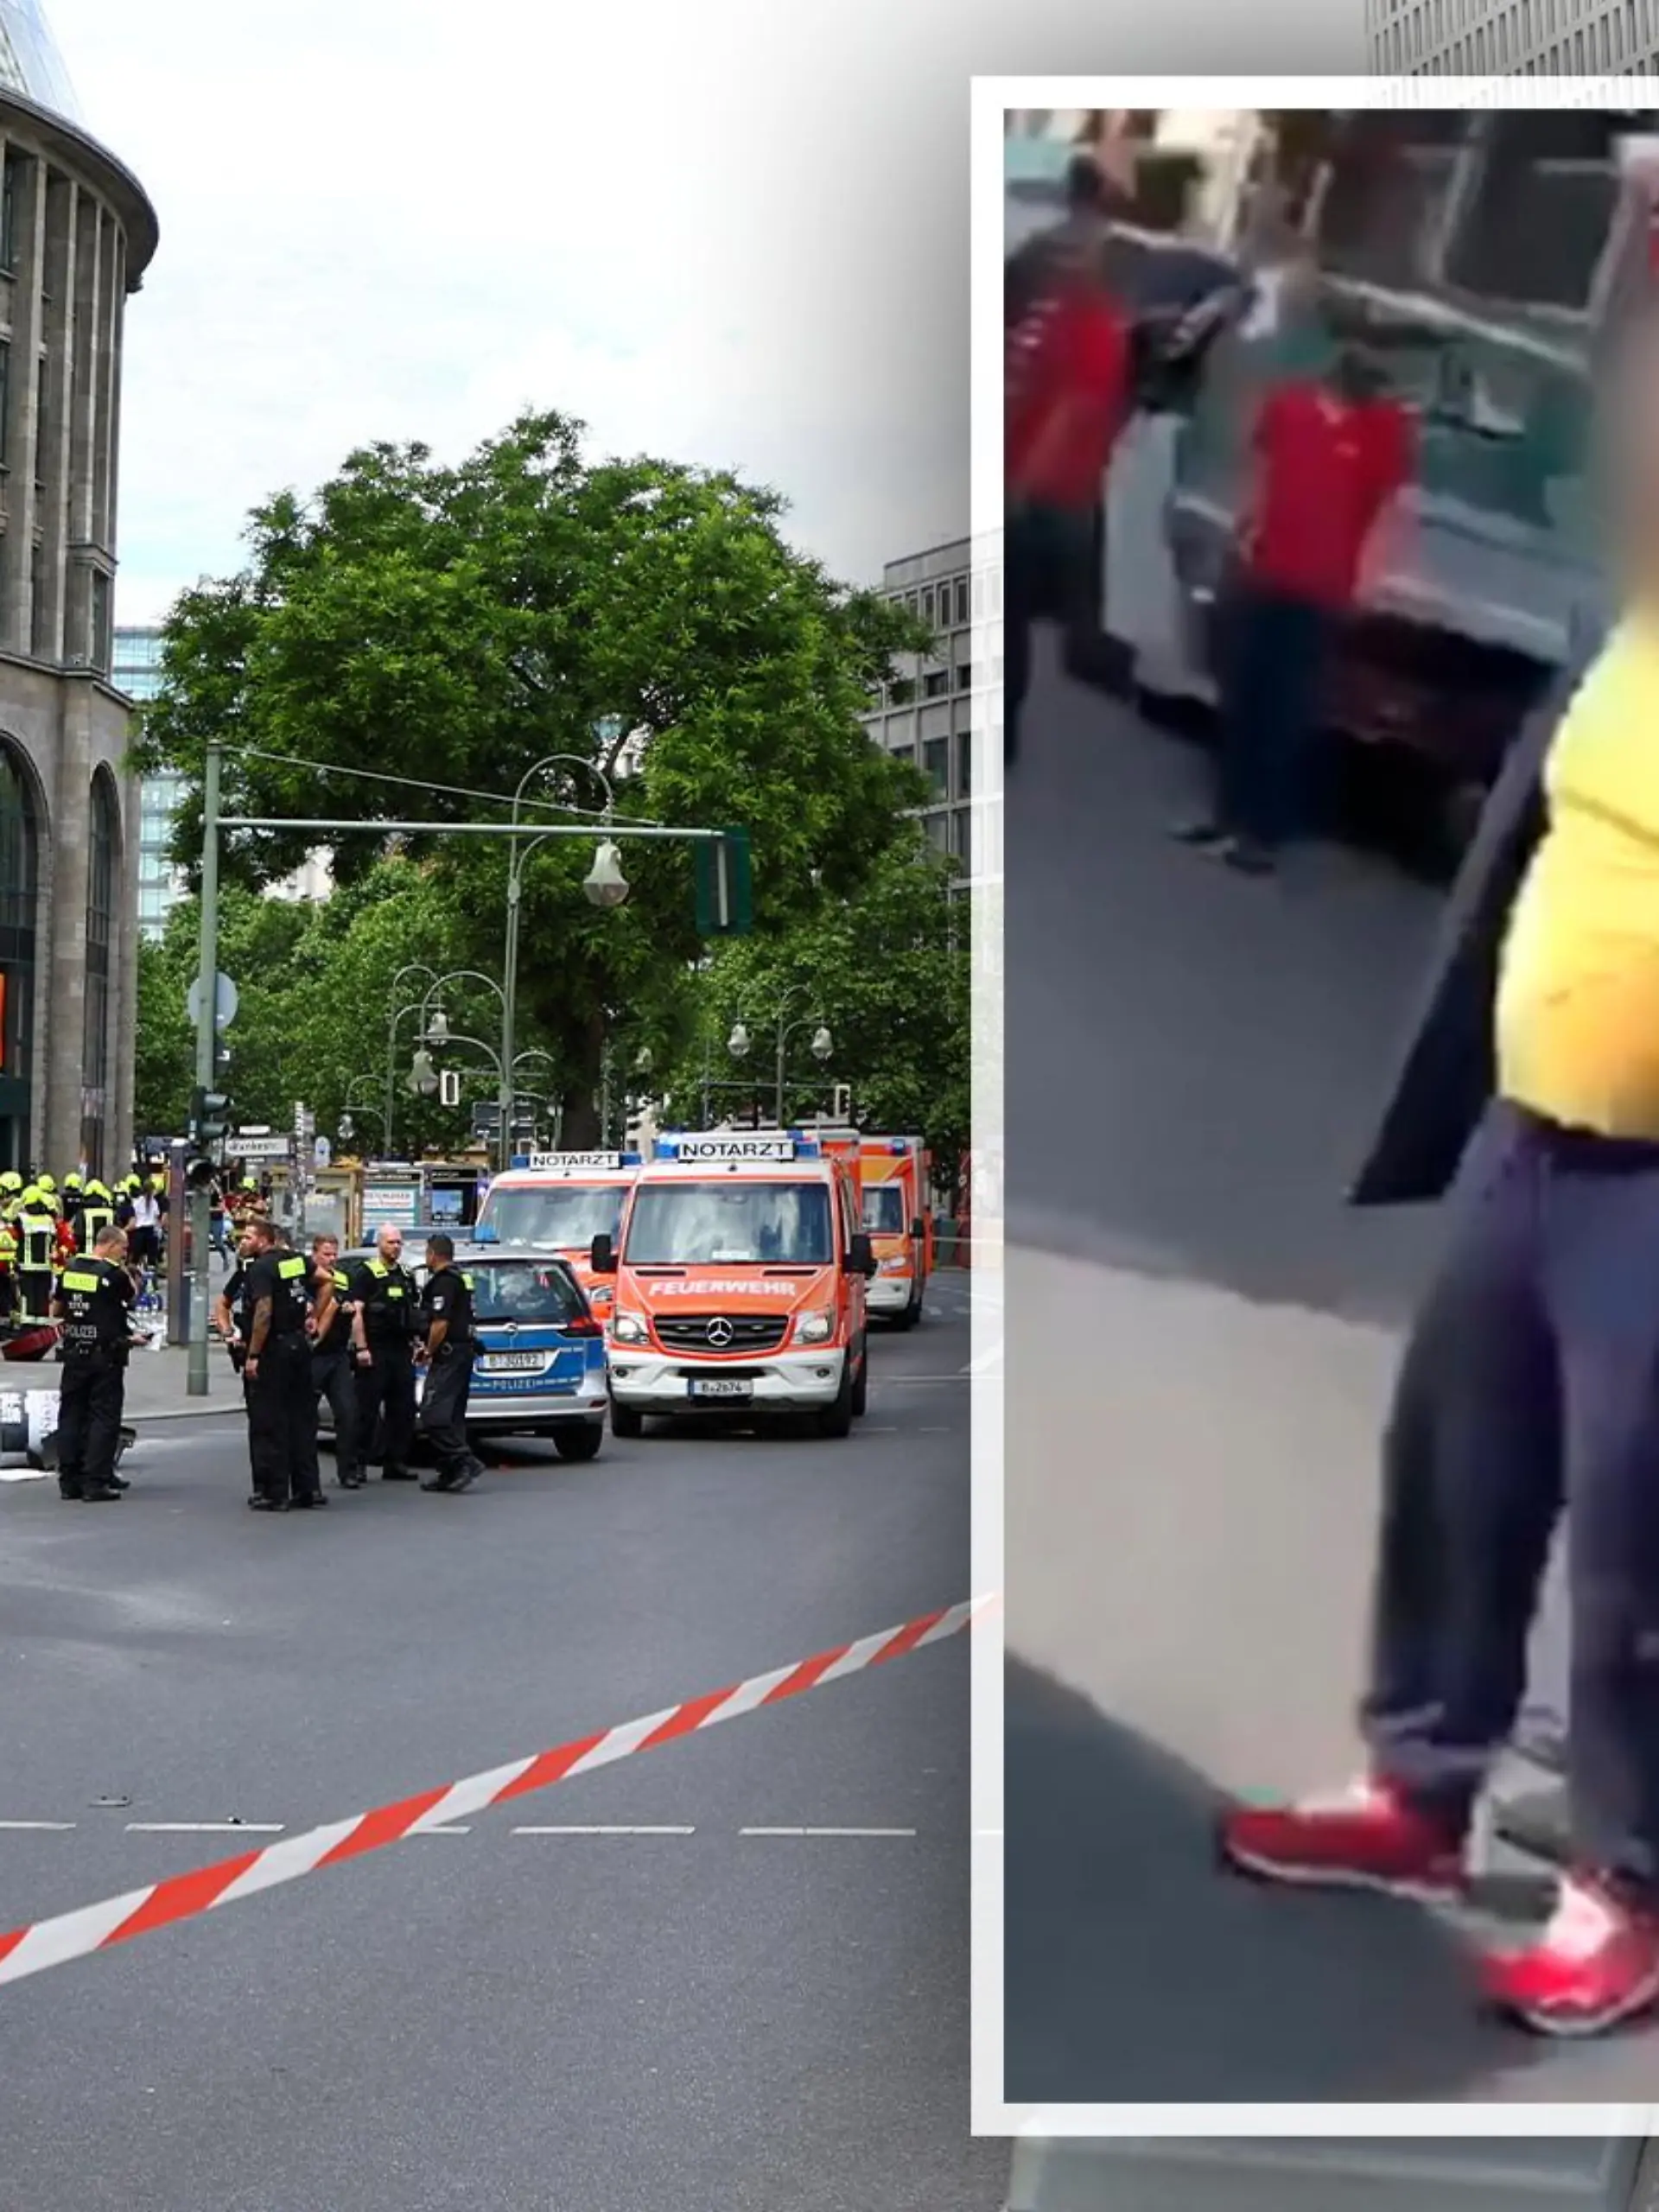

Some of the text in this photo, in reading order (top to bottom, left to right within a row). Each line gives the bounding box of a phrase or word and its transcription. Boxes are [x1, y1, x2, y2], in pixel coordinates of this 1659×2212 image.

[683, 1142, 785, 1157] NOTARZT
[532, 1154, 614, 1166] NOTARZT
[649, 1280, 796, 1295] FEUERWEHR
[493, 1378, 536, 1389] POLIZEI
